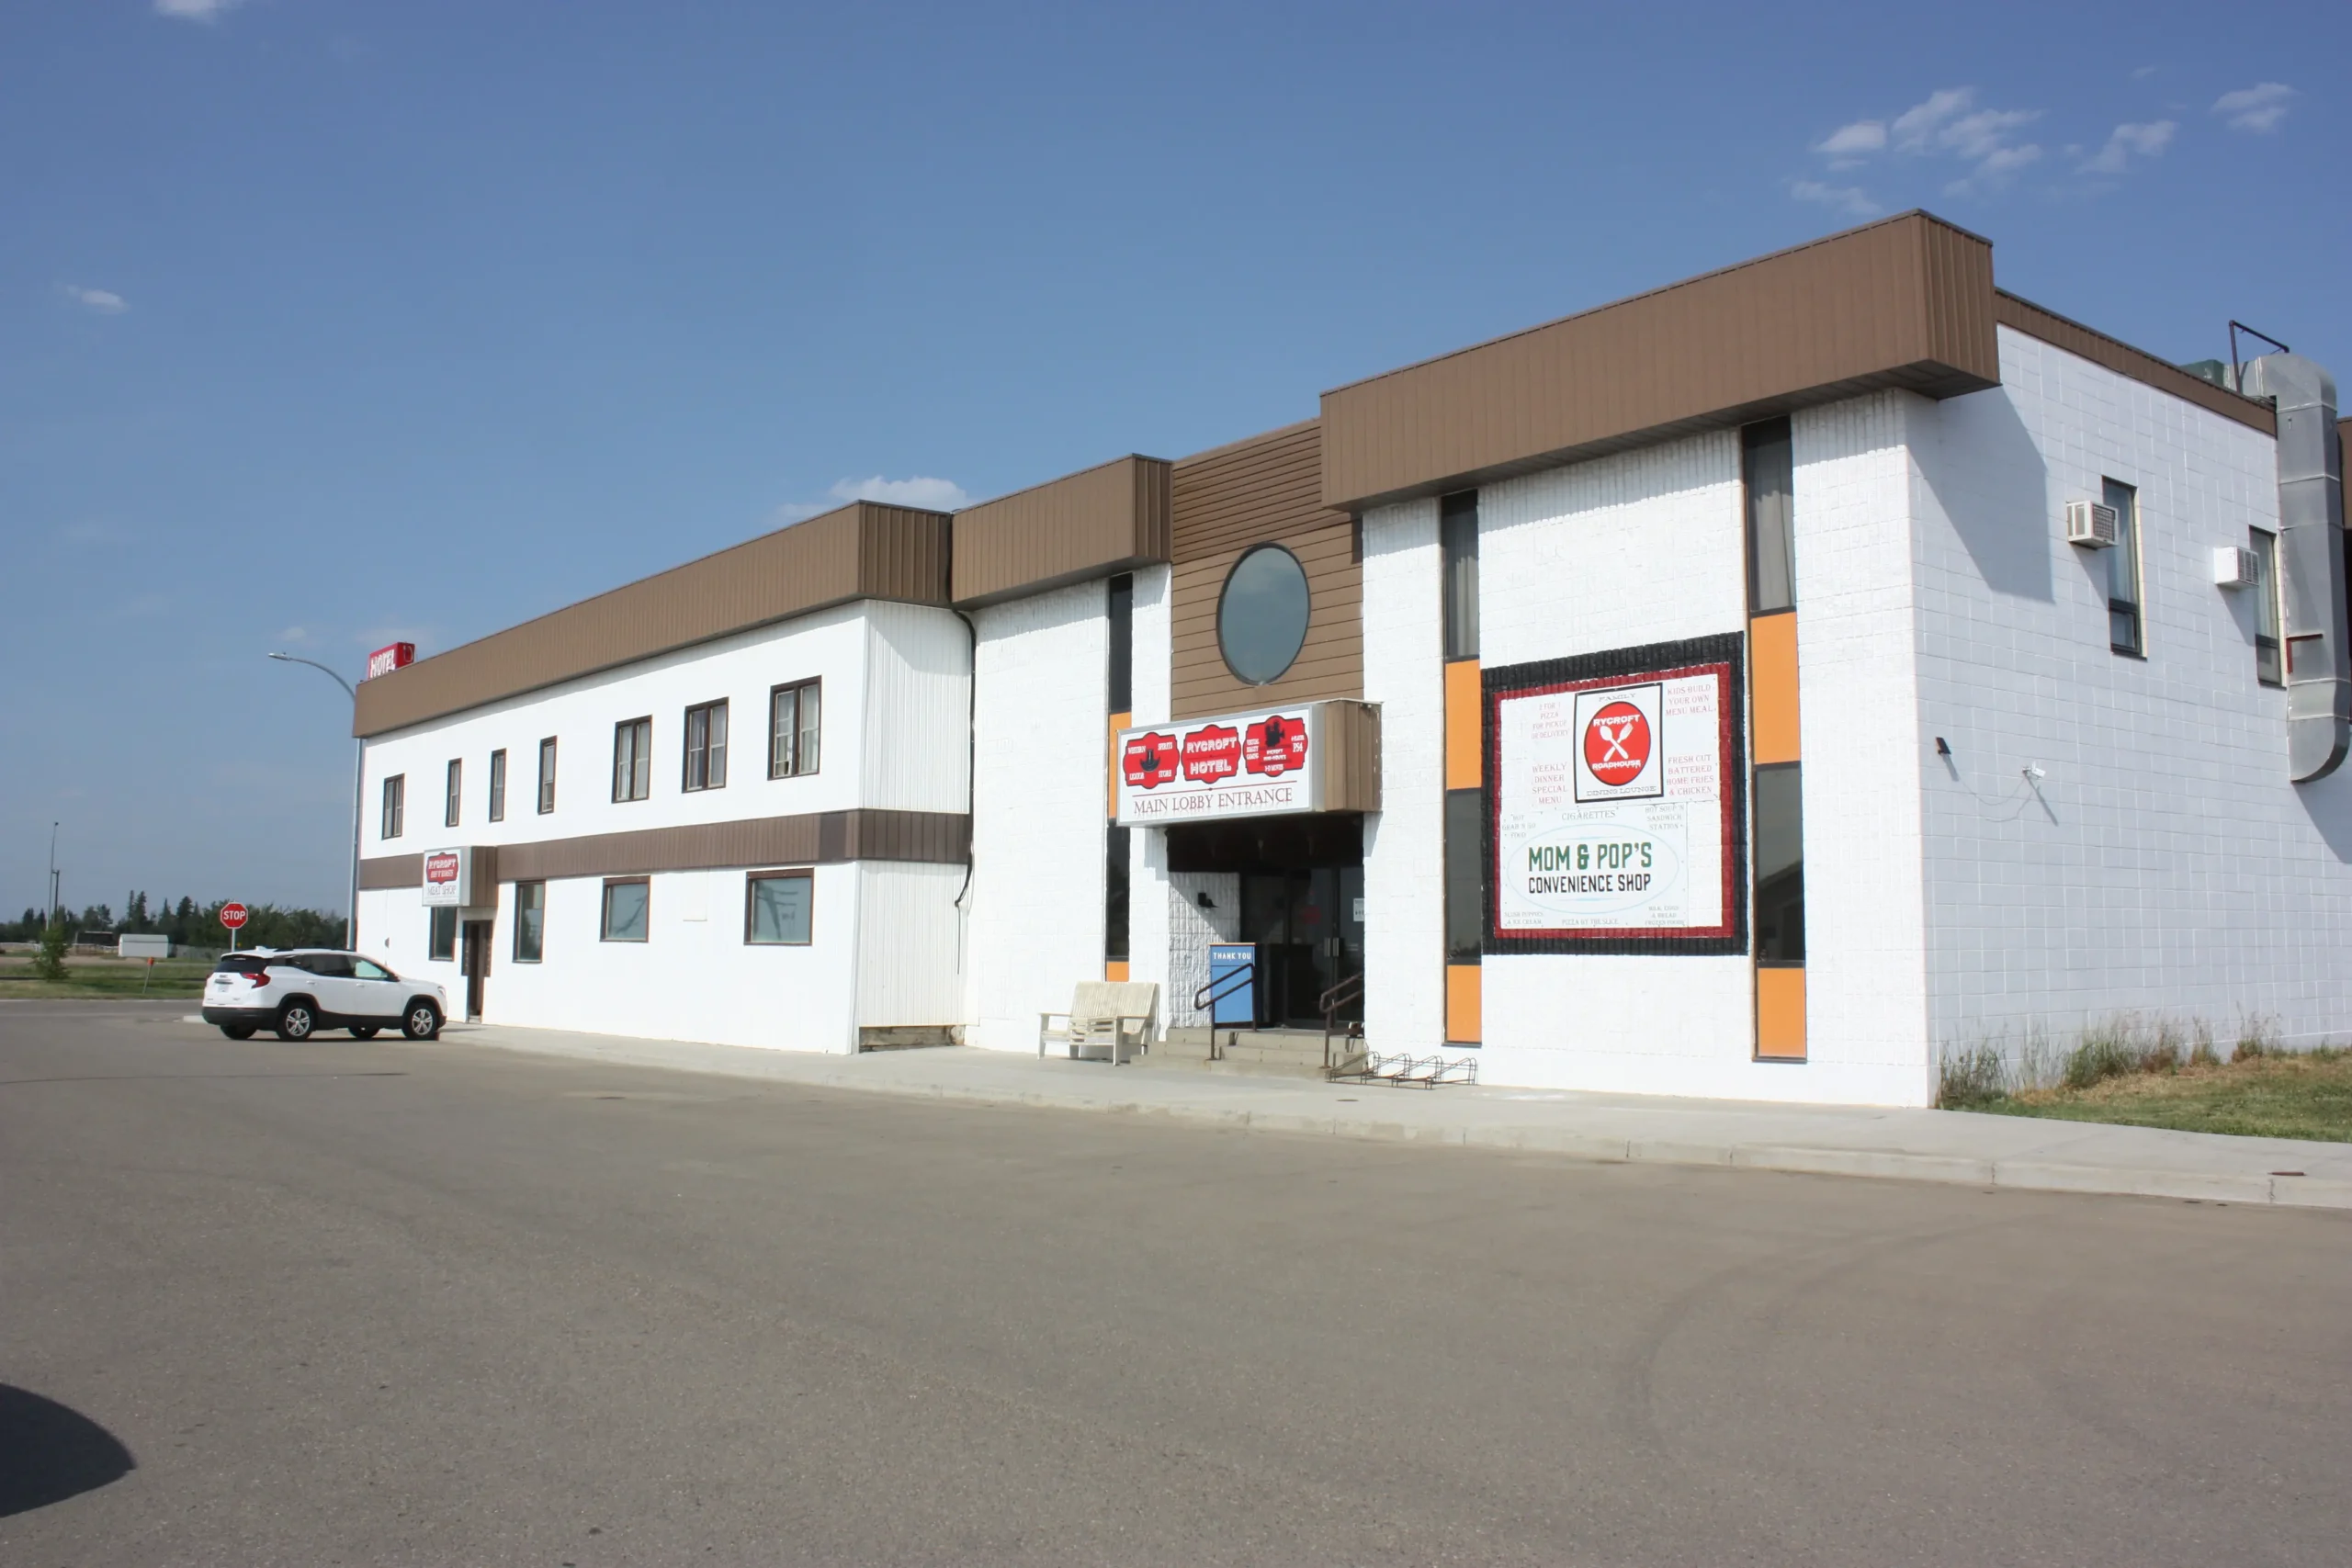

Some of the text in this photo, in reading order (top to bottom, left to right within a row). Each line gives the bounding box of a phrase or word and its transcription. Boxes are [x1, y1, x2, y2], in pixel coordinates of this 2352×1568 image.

[370, 649, 395, 678] HOTEL
[1668, 684, 1711, 695] KIDS BUILD
[1599, 693, 1636, 702] FAMILY
[1691, 694, 1709, 703] OWN
[1540, 711, 1558, 719] PIZZA
[1666, 707, 1687, 716] MENU
[1593, 715, 1641, 727] RYCROFT
[1539, 729, 1567, 739] DELIVERY
[1187, 737, 1237, 753] RYCROFT
[1696, 754, 1712, 762] CUT
[1190, 759, 1232, 775] HOTEL
[1532, 762, 1566, 773] WEEKLY
[1592, 760, 1641, 771] ROADHOUSE
[1668, 765, 1712, 774] BATTERED
[1534, 774, 1565, 783] DINNER
[1667, 775, 1713, 785] HOME FRIES
[1532, 784, 1567, 794] SPECIAL
[1678, 786, 1712, 795] CHICKEN
[1135, 788, 1292, 814] MAIN LOBBY ENTRANCE
[1538, 795, 1562, 804] MENU
[1562, 810, 1615, 820] CIGARETTES
[1646, 814, 1681, 822] SANDWICH
[1529, 841, 1652, 872] MOM & POP'S
[1529, 873, 1651, 894] CONVENIENCE SHOP
[442, 886, 456, 895] SHOP
[223, 910, 245, 920] STOP
[1214, 952, 1251, 960] THANK YOU
